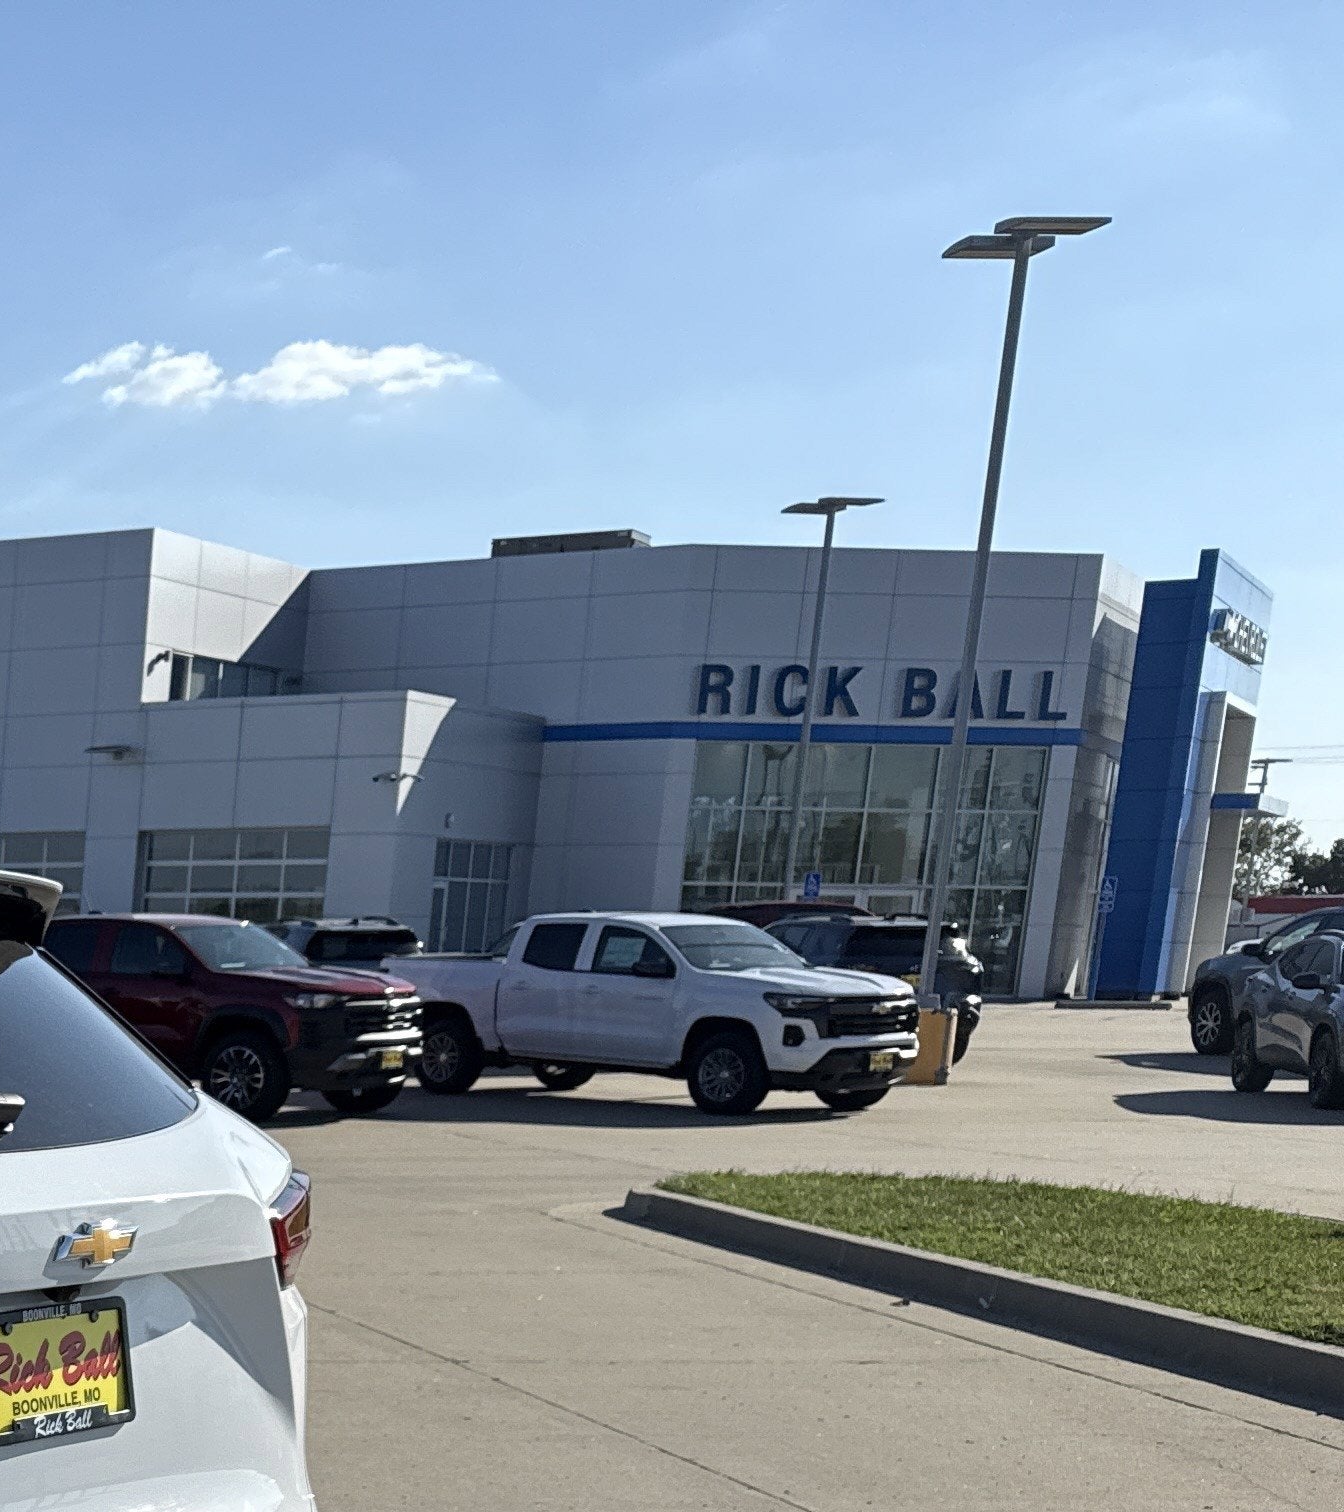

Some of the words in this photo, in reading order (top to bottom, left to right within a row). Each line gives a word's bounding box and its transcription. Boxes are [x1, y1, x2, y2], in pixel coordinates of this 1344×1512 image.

[696, 663, 863, 717] RICK
[22, 1305, 67, 1322] BOONVILLE,
[69, 1303, 82, 1315] MO
[58, 1329, 123, 1386] Ball
[13, 1390, 82, 1416] BOONVILLE,
[84, 1387, 101, 1403] MO
[34, 1415, 64, 1438] Rick
[65, 1409, 93, 1433] Ball
